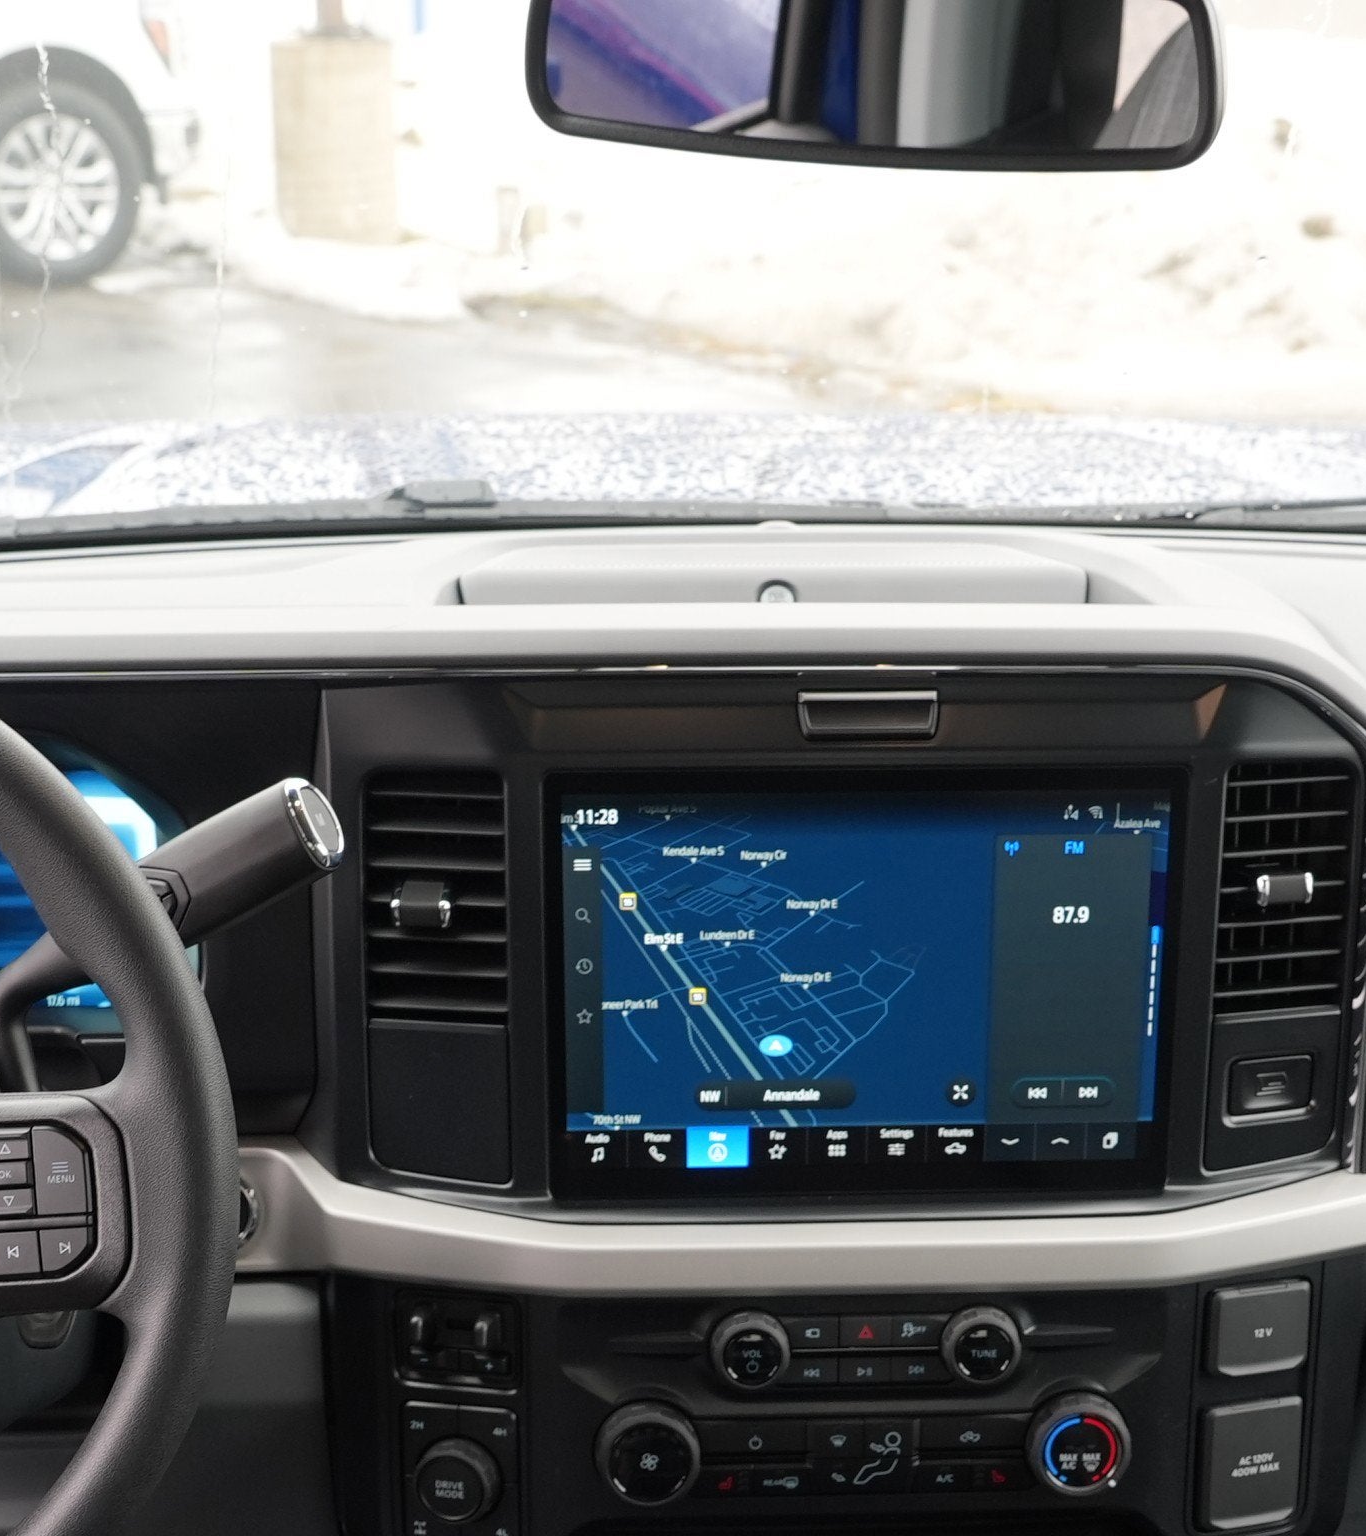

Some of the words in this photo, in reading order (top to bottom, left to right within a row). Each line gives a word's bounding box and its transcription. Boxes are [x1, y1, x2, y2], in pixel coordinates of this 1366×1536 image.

[576, 808, 619, 825] 11:28
[1144, 818, 1161, 828] Ave
[662, 846, 699, 857] Kendale
[699, 846, 717, 856] Ave
[717, 845, 725, 856] S
[1064, 840, 1084, 855] FM
[740, 850, 774, 861] Norway
[786, 900, 819, 910] Norway
[820, 899, 831, 909] Dr
[831, 899, 838, 909] E
[1052, 906, 1090, 924] 87.9
[644, 933, 665, 945] Elm
[675, 932, 684, 944] E
[700, 930, 737, 940] Lundeen
[737, 930, 748, 940] Dr
[748, 930, 755, 939] E
[780, 972, 813, 983] Norway
[814, 972, 824, 982] Dr
[825, 972, 832, 982] E
[625, 1000, 645, 1010] Park
[699, 1090, 721, 1103] NW
[763, 1089, 820, 1102] Annandale
[593, 1114, 614, 1125] 70th
[624, 1114, 641, 1124] NW
[644, 1132, 671, 1143] Phone
[826, 1129, 848, 1141] Apps
[880, 1128, 915, 1141] Settings
[938, 1127, 974, 1138] Features
[585, 1133, 610, 1144] Audio
[47, 1174, 75, 1184] MENU
[1254, 1329, 1264, 1339] 12
[741, 1350, 762, 1359] VOL
[971, 1349, 998, 1359] TUNE
[410, 1420, 424, 1430] 2H
[493, 1427, 507, 1437] 4H
[1059, 1452, 1078, 1461] MAX
[1082, 1452, 1101, 1461] MAX
[1238, 1456, 1252, 1466] AC
[1253, 1452, 1274, 1464] 120V
[1231, 1465, 1258, 1477] 400W
[1259, 1462, 1280, 1474] MAX
[936, 1474, 953, 1483] A/C
[435, 1480, 464, 1490] DRIVE
[435, 1490, 464, 1499] MODE
